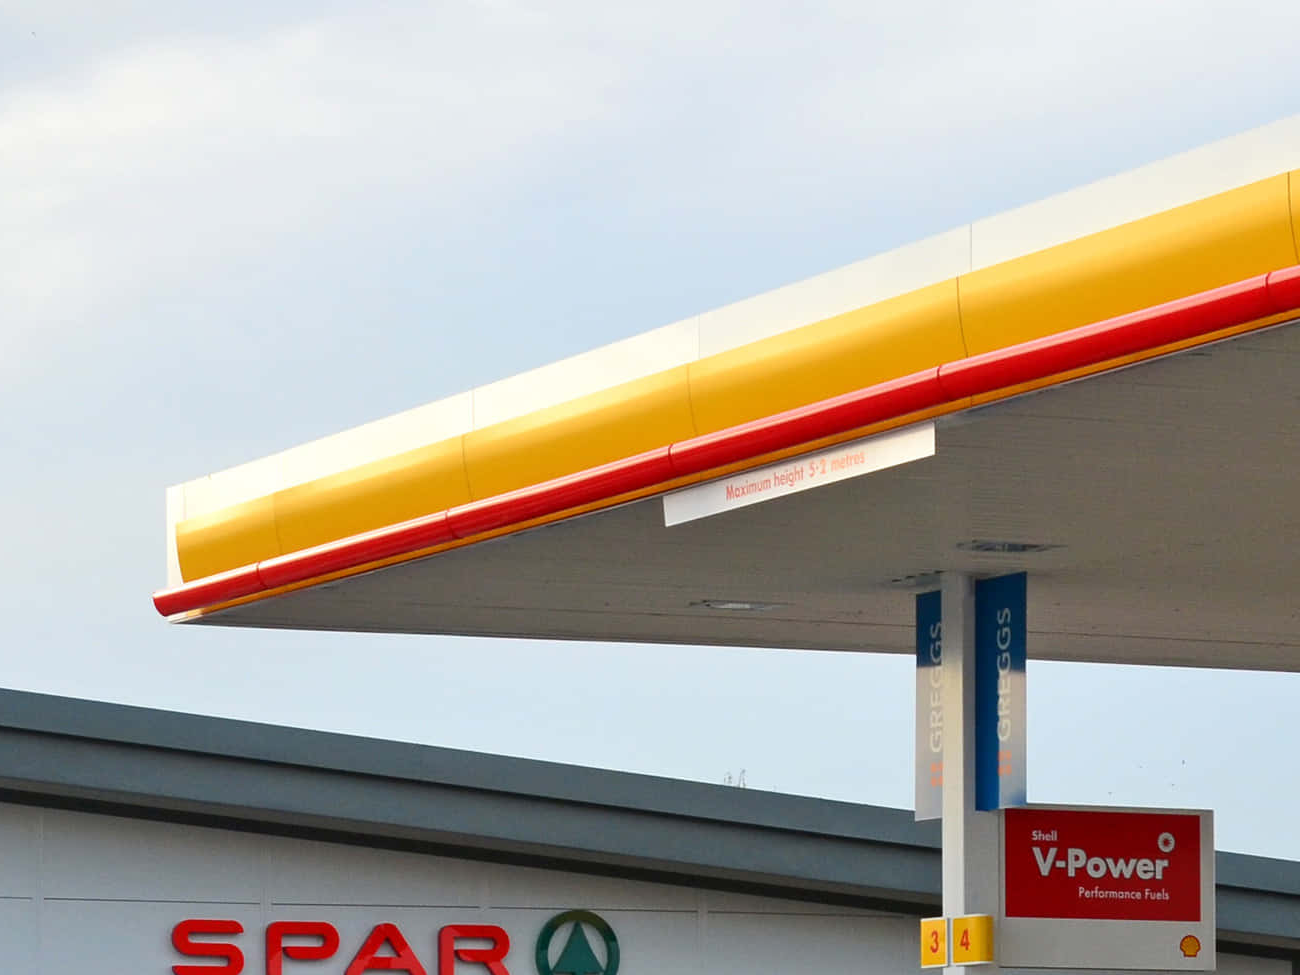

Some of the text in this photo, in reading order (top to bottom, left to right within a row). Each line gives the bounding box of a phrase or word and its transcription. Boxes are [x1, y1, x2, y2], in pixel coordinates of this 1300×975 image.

[726, 477, 771, 501] Maximum
[773, 464, 805, 488] height
[830, 451, 866, 472] metres
[997, 607, 1012, 743] GREGGS
[1031, 830, 1058, 842] Shell
[1032, 846, 1169, 880] V-Power
[1078, 886, 1170, 901] Performance Fuels
[929, 930, 940, 953] 3
[959, 928, 970, 951] 4
